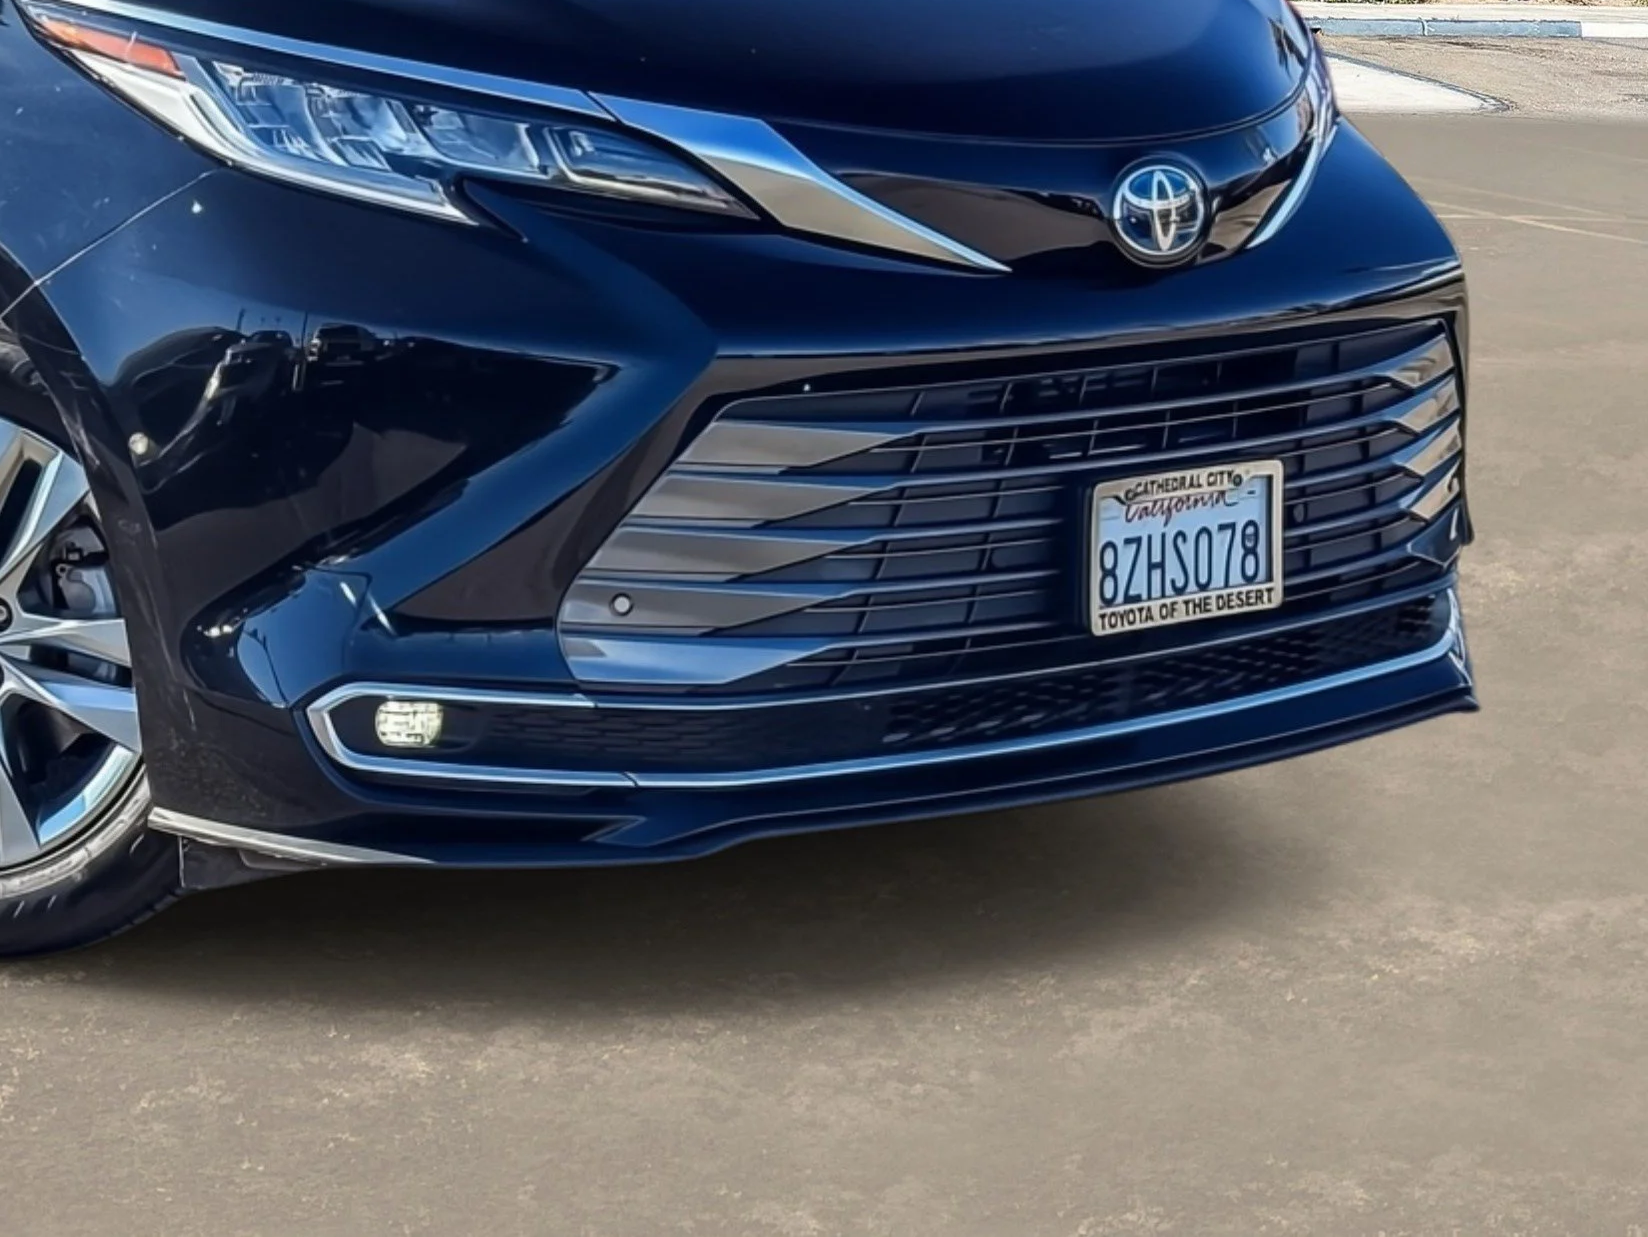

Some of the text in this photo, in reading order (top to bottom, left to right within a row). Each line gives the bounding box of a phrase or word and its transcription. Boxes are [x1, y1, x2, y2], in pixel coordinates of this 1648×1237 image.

[1134, 470, 1234, 495] CATHEDRAL CITY
[1124, 490, 1239, 526] California
[1099, 519, 1260, 607] 8ZHS078
[1099, 587, 1275, 630] TOYOTA OF THE DESERT
